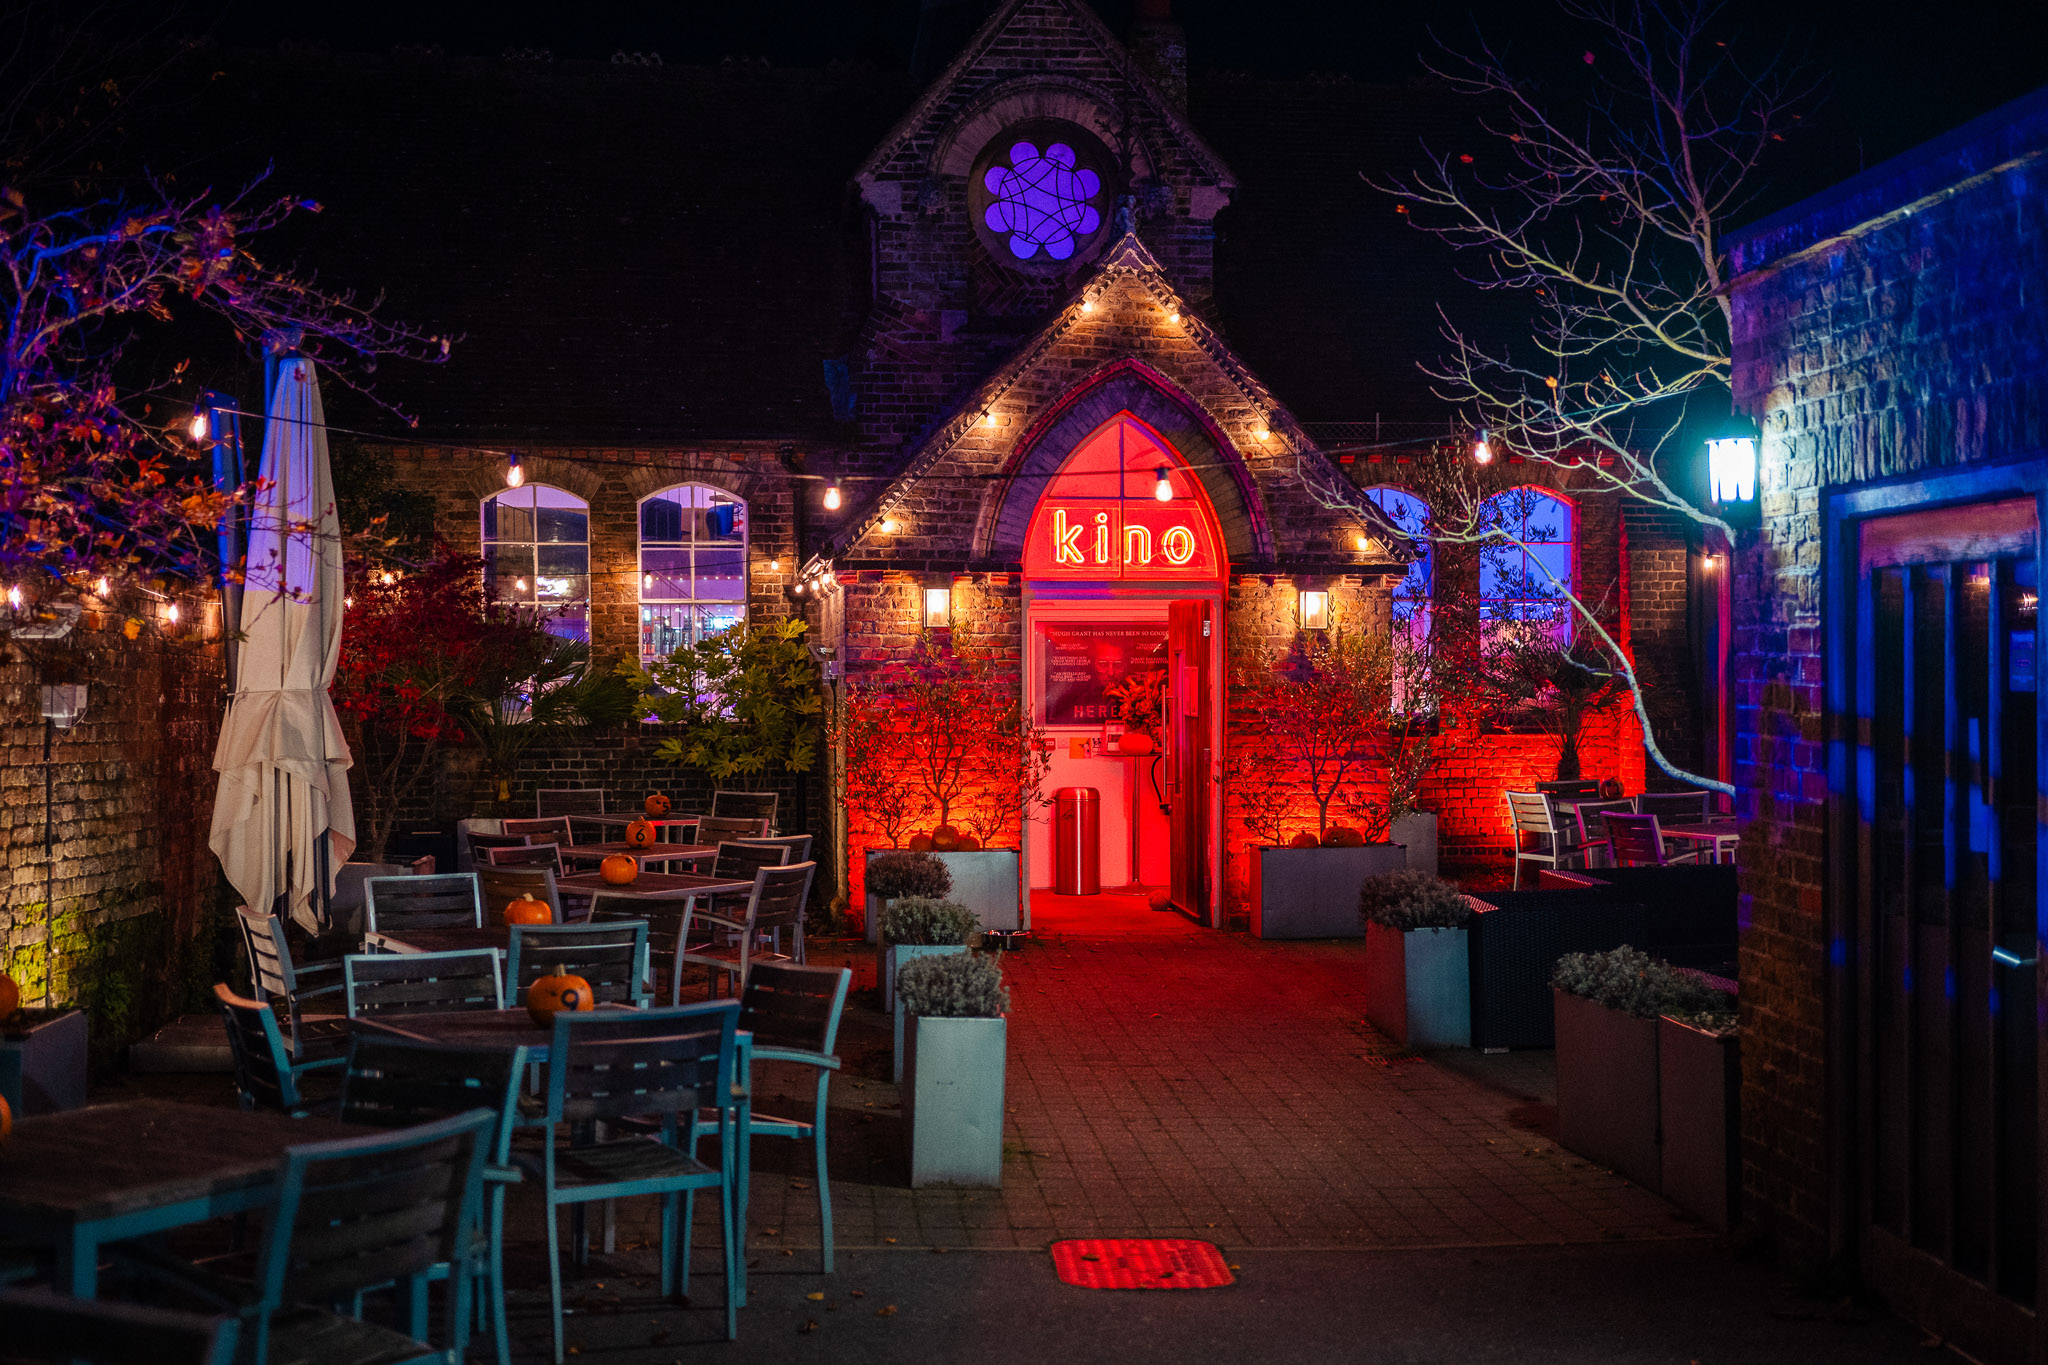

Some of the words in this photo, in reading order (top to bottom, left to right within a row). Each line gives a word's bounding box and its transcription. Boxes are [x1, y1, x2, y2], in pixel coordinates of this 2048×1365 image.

[1055, 510, 1195, 564] kino
[1074, 705, 1118, 718] HERE
[636, 828, 645, 842] 6
